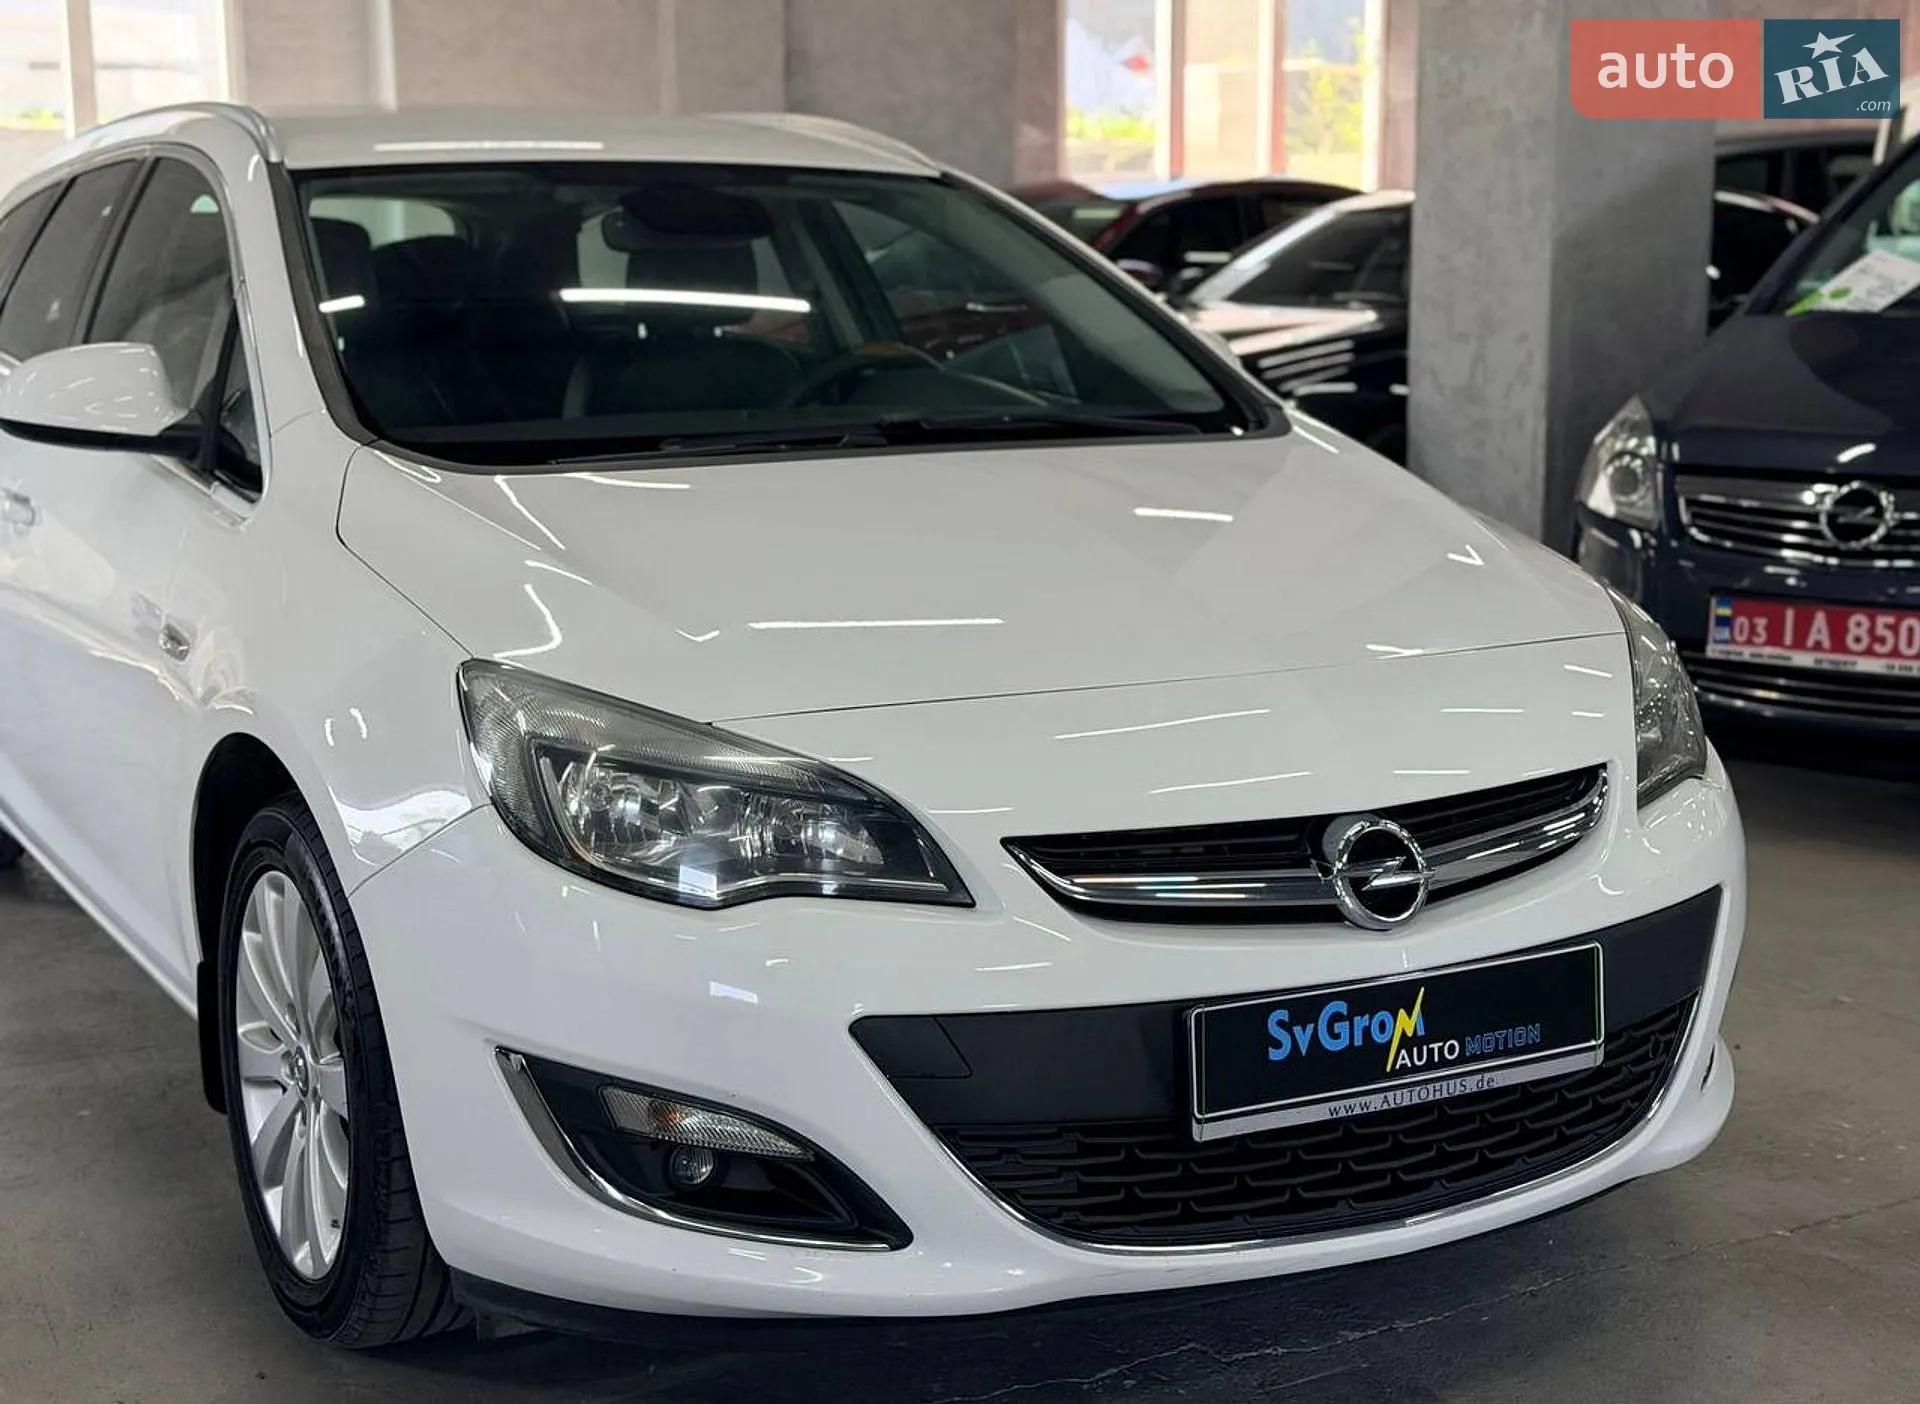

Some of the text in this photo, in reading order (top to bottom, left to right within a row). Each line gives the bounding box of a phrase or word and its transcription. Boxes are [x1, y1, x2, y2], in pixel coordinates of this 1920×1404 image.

[1733, 615, 1769, 645] 03
[1395, 1022, 1541, 1070] AUTO MOTION
[1328, 1072, 1496, 1118] www.AUTOHUS.de
